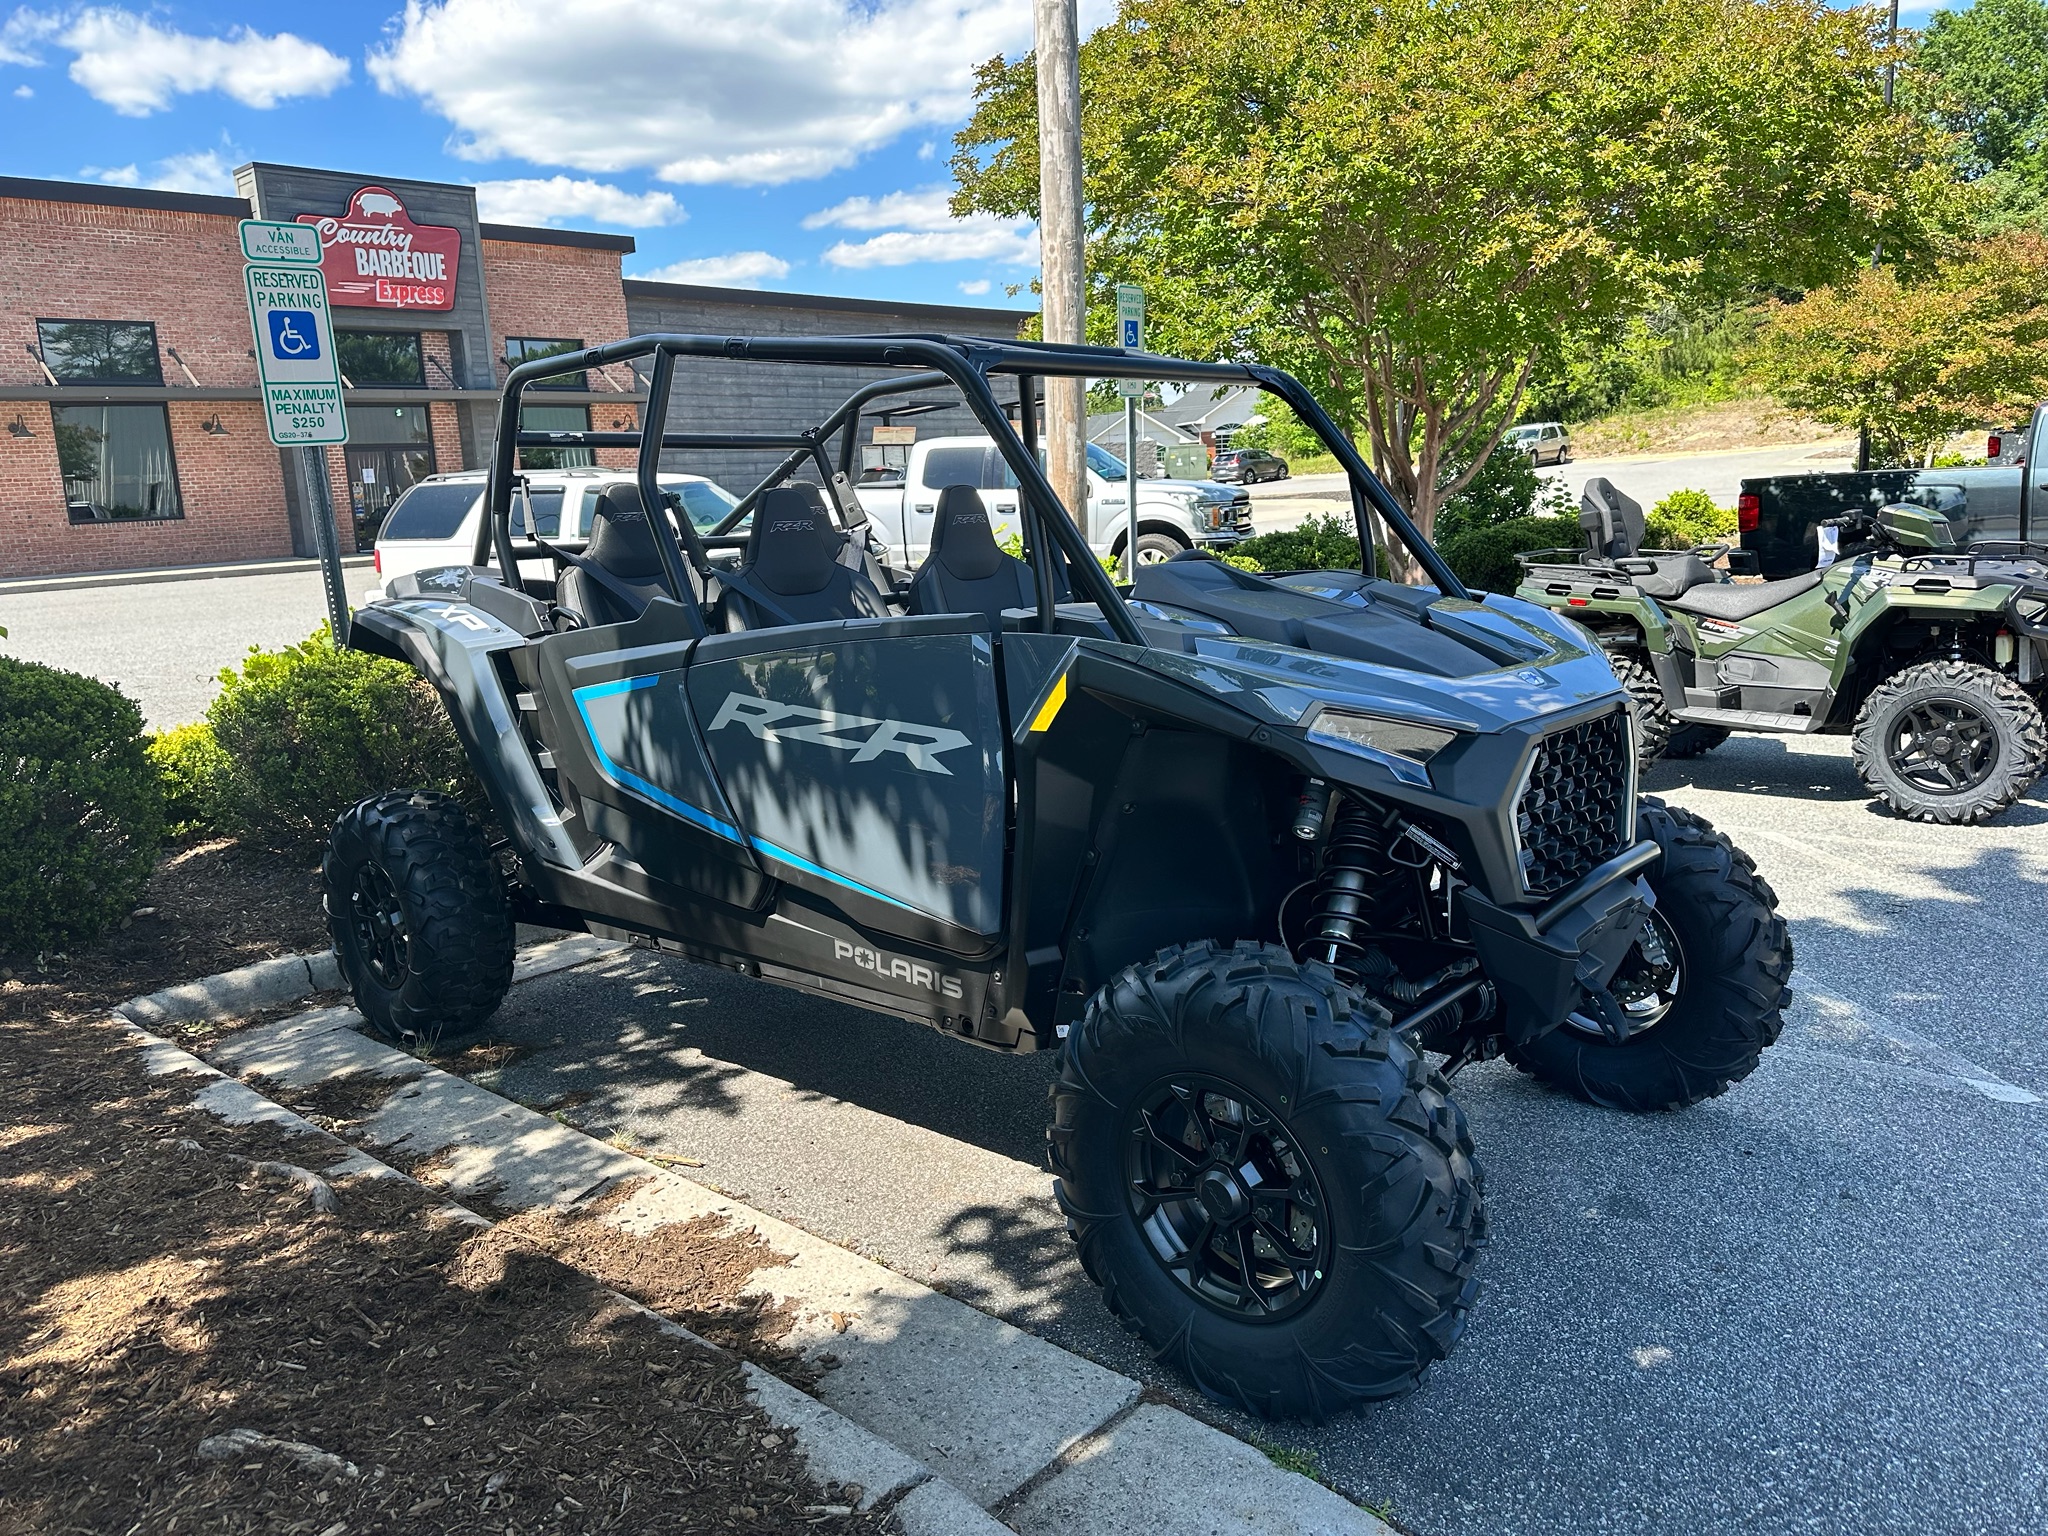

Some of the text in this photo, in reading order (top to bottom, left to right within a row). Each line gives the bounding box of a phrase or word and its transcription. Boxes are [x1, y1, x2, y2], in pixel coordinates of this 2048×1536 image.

[268, 231, 294, 244] VAN
[315, 218, 413, 252] Country
[256, 244, 310, 256] ACCESSIBLE
[354, 247, 447, 282] BARBEQUE
[253, 271, 319, 289] RESERVED
[257, 291, 321, 308] PARKING
[376, 279, 444, 308] Express
[1122, 306, 1140, 317] PARKING
[271, 389, 336, 401] MAXIMUM
[275, 403, 335, 415] PENALTY
[292, 417, 325, 429] $250
[770, 519, 814, 533] RZR
[952, 513, 986, 526] RZR
[427, 604, 491, 631] XP
[707, 691, 973, 776] RZR
[834, 938, 963, 999] POLARIS
